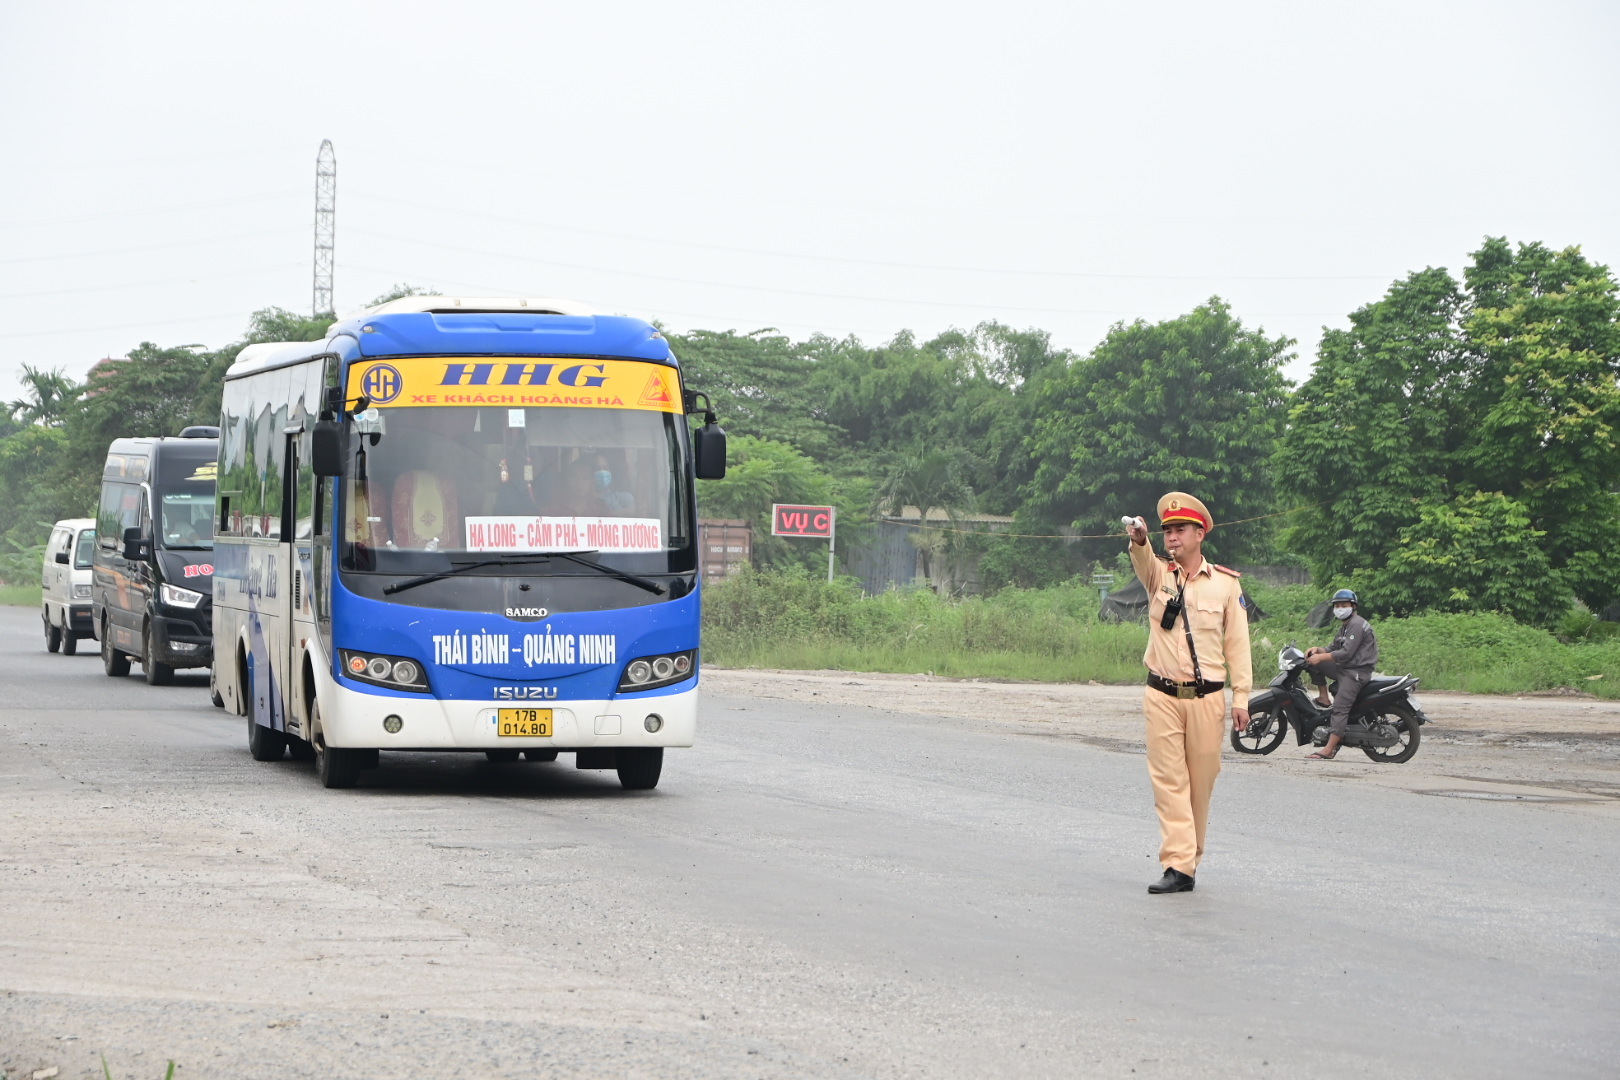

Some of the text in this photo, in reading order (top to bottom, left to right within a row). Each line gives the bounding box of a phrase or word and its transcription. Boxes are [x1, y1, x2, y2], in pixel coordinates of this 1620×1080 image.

[435, 363, 610, 388] HHG
[411, 393, 624, 406] XE KHÁCH HOÀNG HÀ
[781, 512, 829, 534] VỤ C
[470, 523, 485, 552] HẠ
[487, 523, 517, 547] LONG
[527, 516, 551, 547] CẨM
[555, 517, 579, 547] PHẢ
[587, 520, 619, 548] MÔNG
[622, 522, 659, 549] DƯƠNG
[505, 608, 548, 617] SAMCO
[432, 623, 616, 668] THÁI BÌNH QUẢNG NINH
[493, 686, 558, 699] ISUZU
[515, 710, 537, 722] 17B
[504, 723, 547, 735] 014.80
